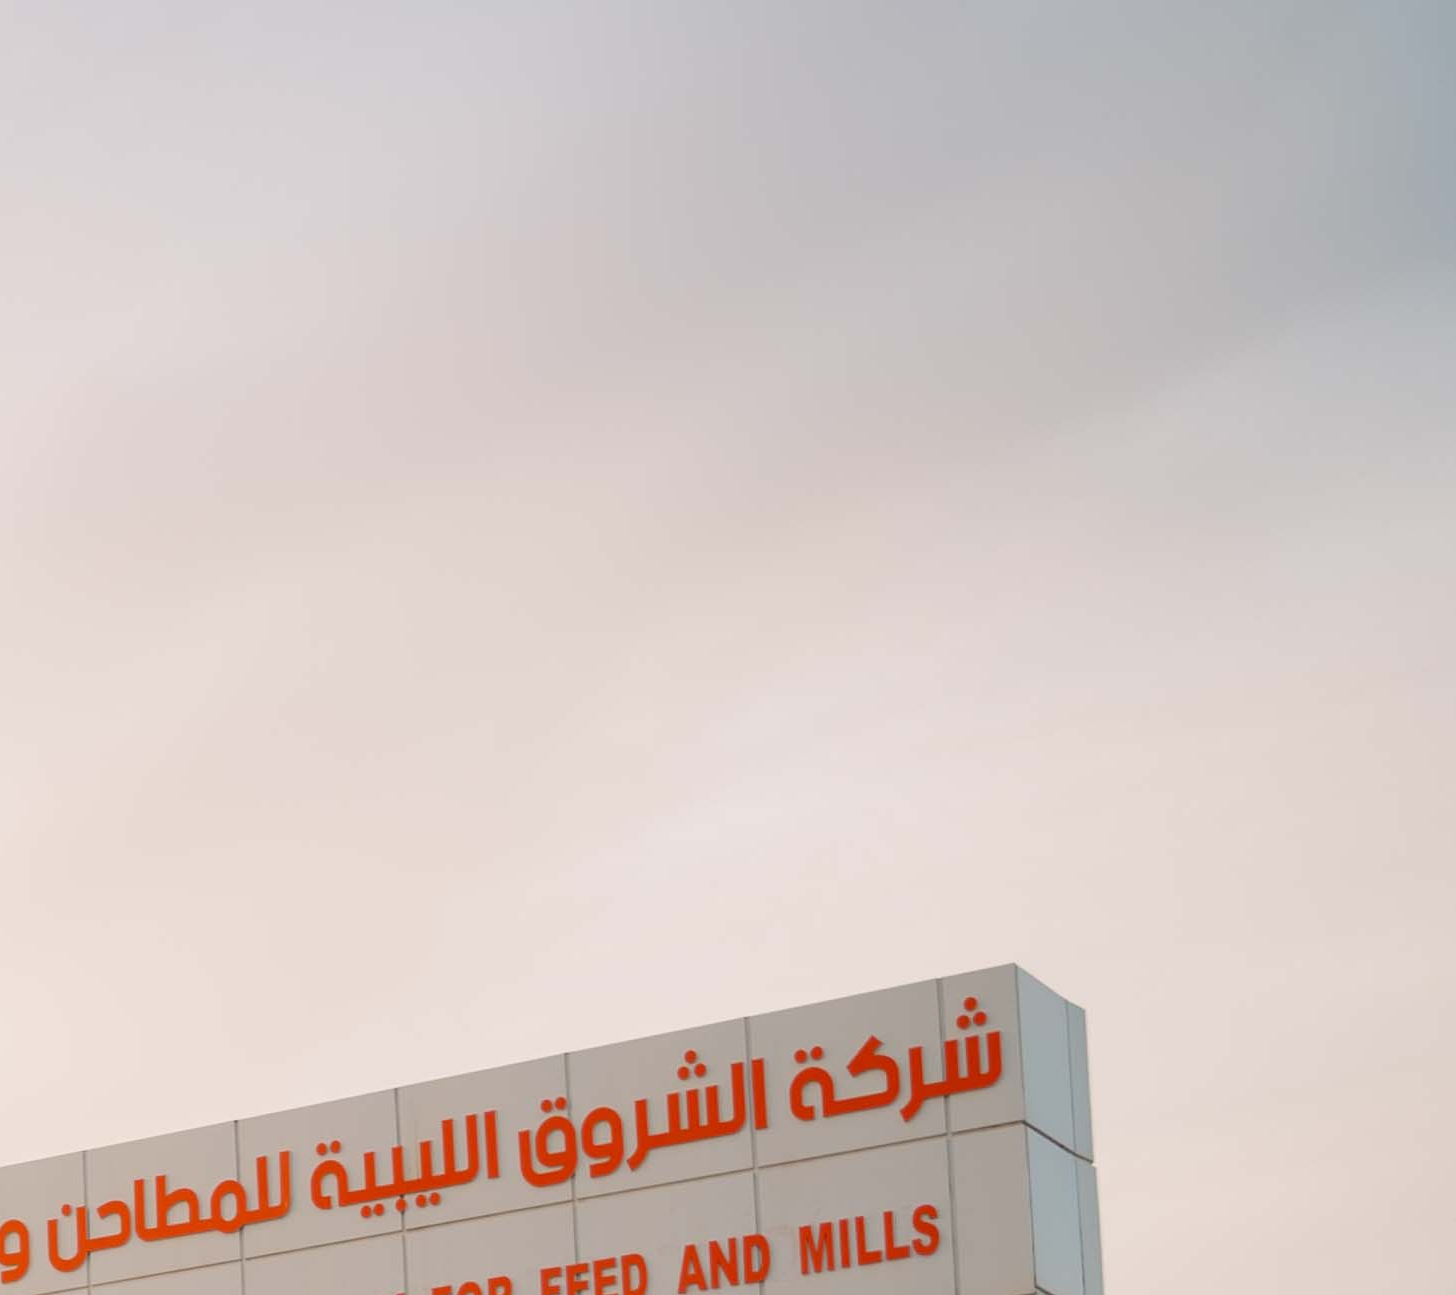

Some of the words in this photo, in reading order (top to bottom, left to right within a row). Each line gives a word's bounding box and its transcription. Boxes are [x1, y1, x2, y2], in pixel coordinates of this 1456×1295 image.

[519, 1050, 767, 1187] الشروق
[790, 997, 1002, 1121] شركة
[48, 1152, 291, 1272] للمطاحن
[311, 1111, 499, 1217] الليبية
[679, 1234, 770, 1293] AND
[800, 1205, 940, 1274] MILLS
